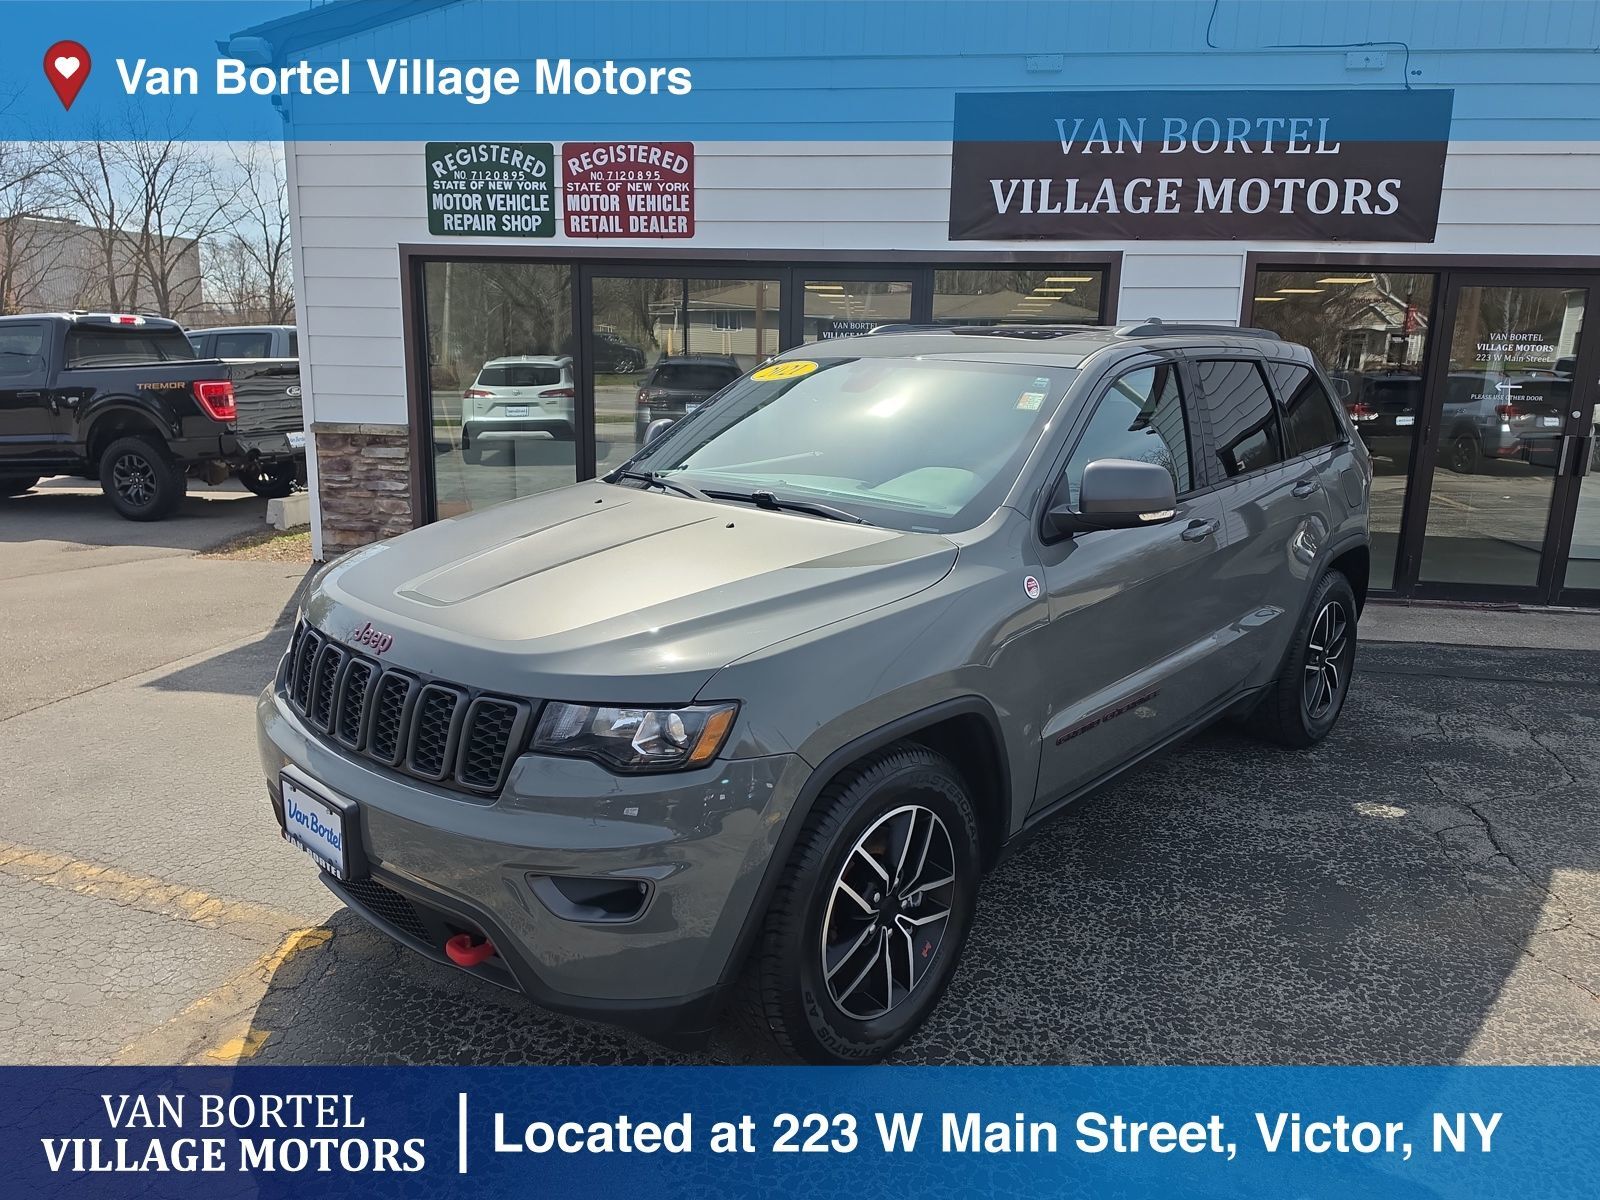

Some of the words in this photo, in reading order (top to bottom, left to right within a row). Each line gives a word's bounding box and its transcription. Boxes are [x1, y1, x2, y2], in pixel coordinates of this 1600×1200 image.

[1055, 118, 1146, 155] VAN
[1161, 118, 1341, 155] BORTEL
[431, 144, 547, 178] REGISTERED
[567, 144, 689, 177] REGISTERED
[454, 171, 468, 180] NO.
[471, 171, 525, 180] 7120895
[590, 171, 605, 180] NO.
[607, 171, 661, 180] 7120895
[433, 181, 468, 190] STATE
[470, 181, 485, 190] OF
[488, 181, 514, 190] NEW
[516, 181, 547, 191] YORK
[567, 182, 602, 192] STATE
[608, 182, 622, 192] OF
[627, 182, 653, 192] NEW
[657, 182, 690, 192] YORK
[432, 194, 482, 211] MOTOR
[487, 194, 549, 212] VEHICLE
[567, 195, 620, 212] MOTOR
[627, 195, 690, 212] VEHICLE
[989, 178, 1182, 215] VILLAGE
[1194, 178, 1401, 216] MOTORS
[444, 214, 496, 231] REPAIR
[501, 214, 542, 232] SHOP
[570, 215, 623, 232] RETAIL
[630, 215, 687, 233] DEALER
[1490, 333, 1507, 341] VAN
[1509, 333, 1543, 341] BORTEL
[1477, 343, 1514, 351] VILLAGE
[1515, 344, 1554, 352] MOTORS
[1493, 354, 1502, 362] W
[1504, 354, 1524, 362] Main
[136, 382, 186, 390] TREMOR
[354, 621, 393, 655] Jeep
[288, 798, 310, 828] Van
[310, 812, 341, 851] Bortel
